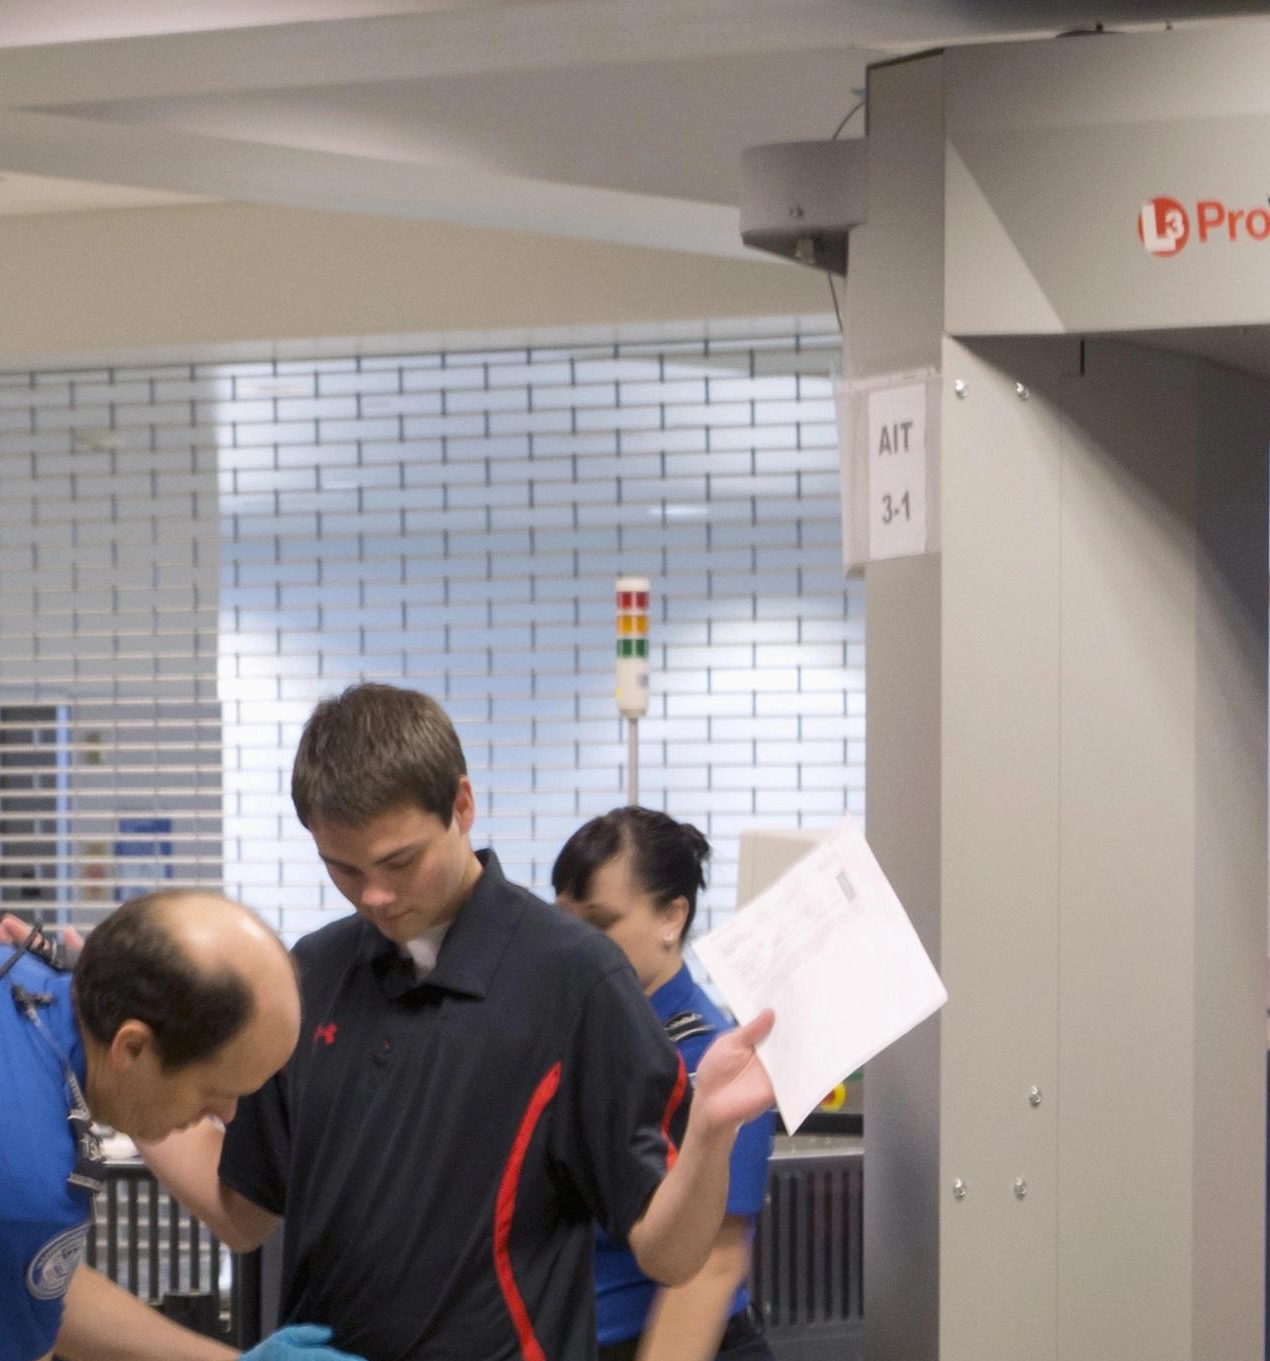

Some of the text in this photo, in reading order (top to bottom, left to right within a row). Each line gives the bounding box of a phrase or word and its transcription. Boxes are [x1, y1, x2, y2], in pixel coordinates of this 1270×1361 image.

[1140, 201, 1187, 253] L3
[879, 421, 913, 455] AIT
[882, 491, 911, 525] 3-1
